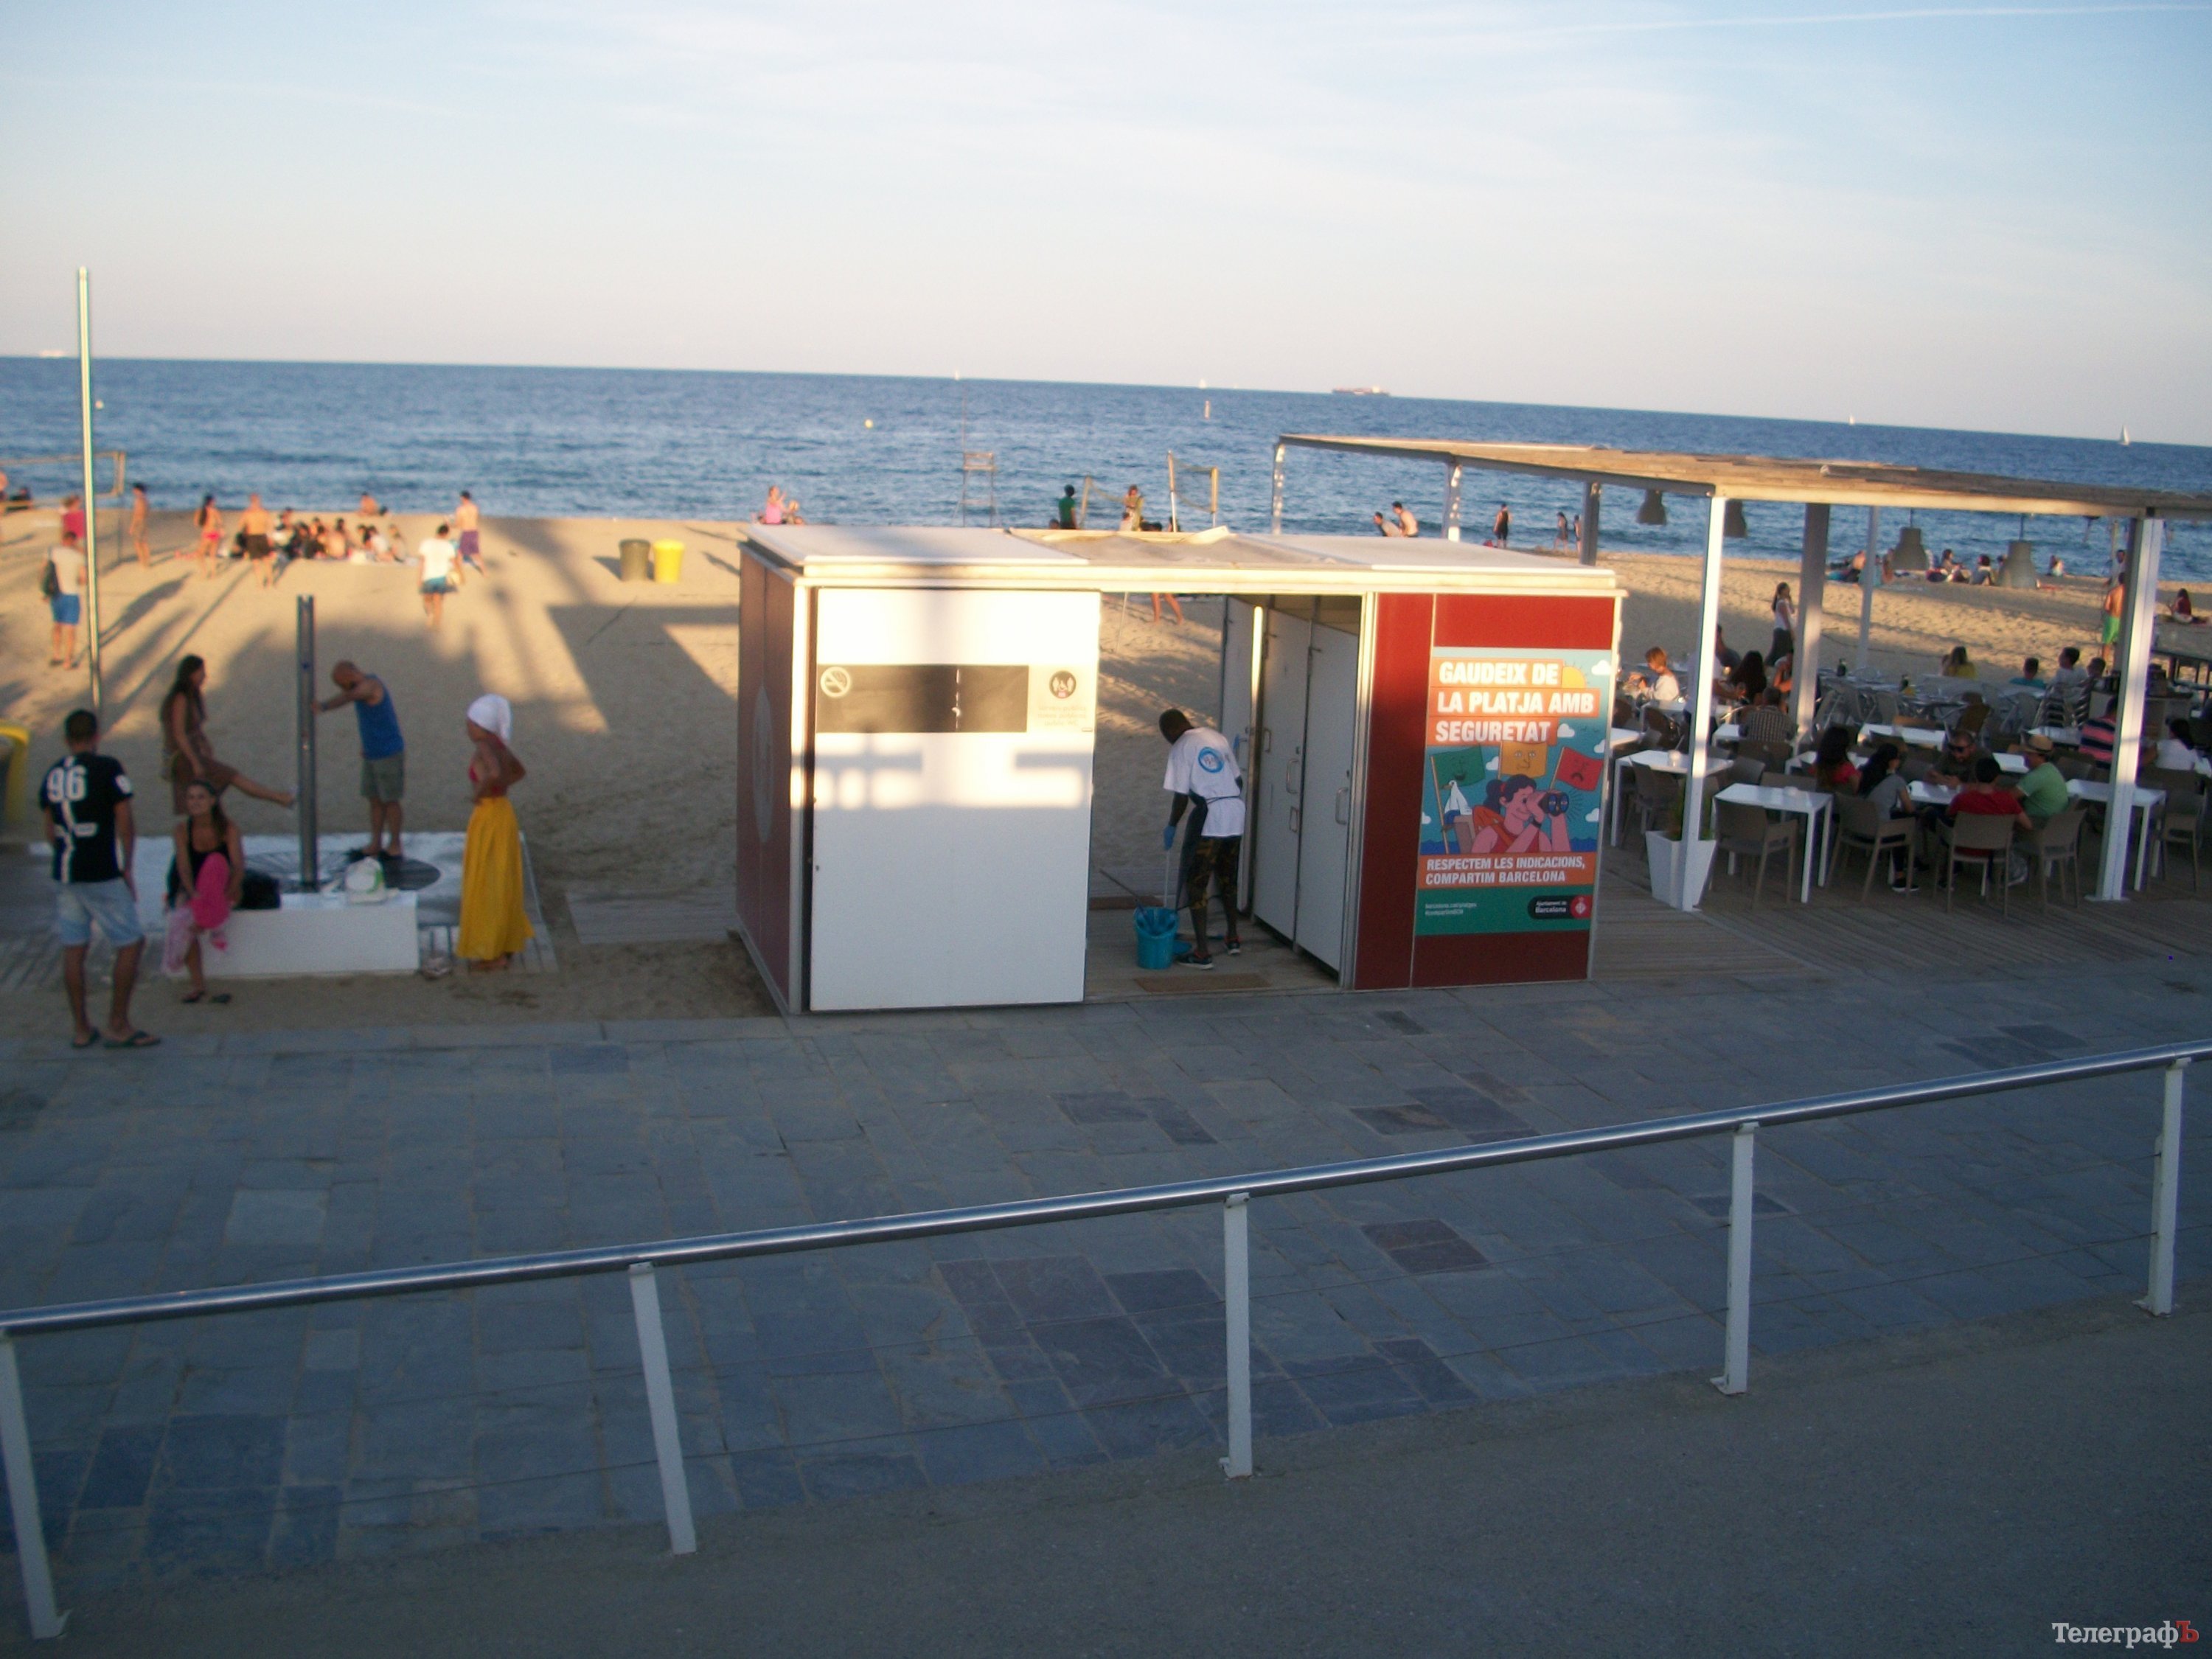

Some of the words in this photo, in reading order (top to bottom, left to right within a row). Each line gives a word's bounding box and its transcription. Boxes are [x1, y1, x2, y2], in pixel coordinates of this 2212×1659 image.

[1439, 661, 1526, 685] GAUDEIX
[1531, 663, 1559, 685] DE
[1437, 692, 1463, 713] LA
[1468, 692, 1543, 713] PLATJA
[1548, 692, 1593, 714] AMB
[1435, 720, 1551, 742] SEGURETAT
[47, 764, 87, 803] 96
[1427, 858, 1491, 870] RESPECTEM
[1494, 857, 1514, 869] LES
[1516, 855, 1585, 869] INDICACIONS,
[1425, 872, 1495, 885] COMPARTIM
[1498, 870, 1565, 883] BARCELONA
[1535, 905, 1566, 914] Barcelona
